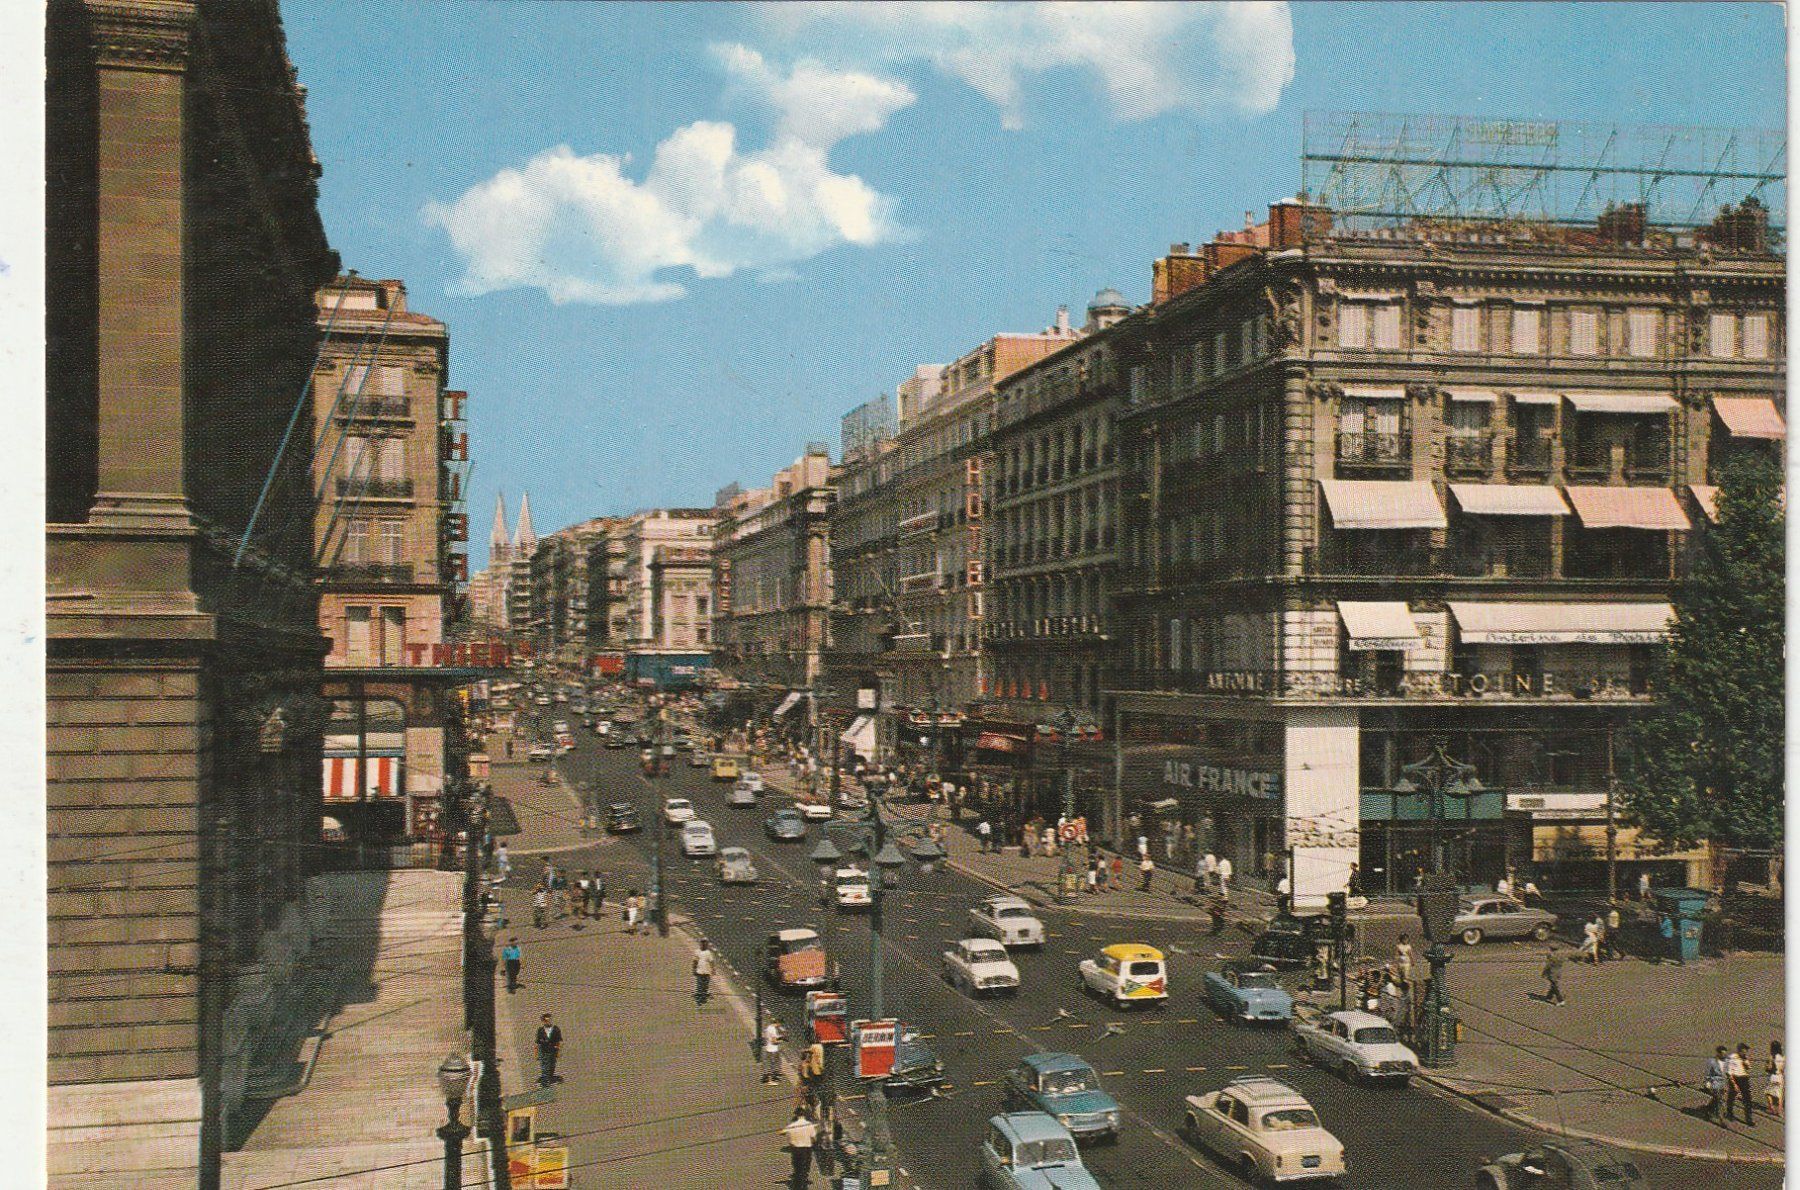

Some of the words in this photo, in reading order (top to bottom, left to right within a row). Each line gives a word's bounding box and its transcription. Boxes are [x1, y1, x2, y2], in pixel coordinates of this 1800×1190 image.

[966, 456, 983, 619] HOTEL
[1398, 674, 1553, 693] ANTOINE
[1163, 760, 1193, 789] AIR
[1197, 765, 1279, 799] FRANCE
